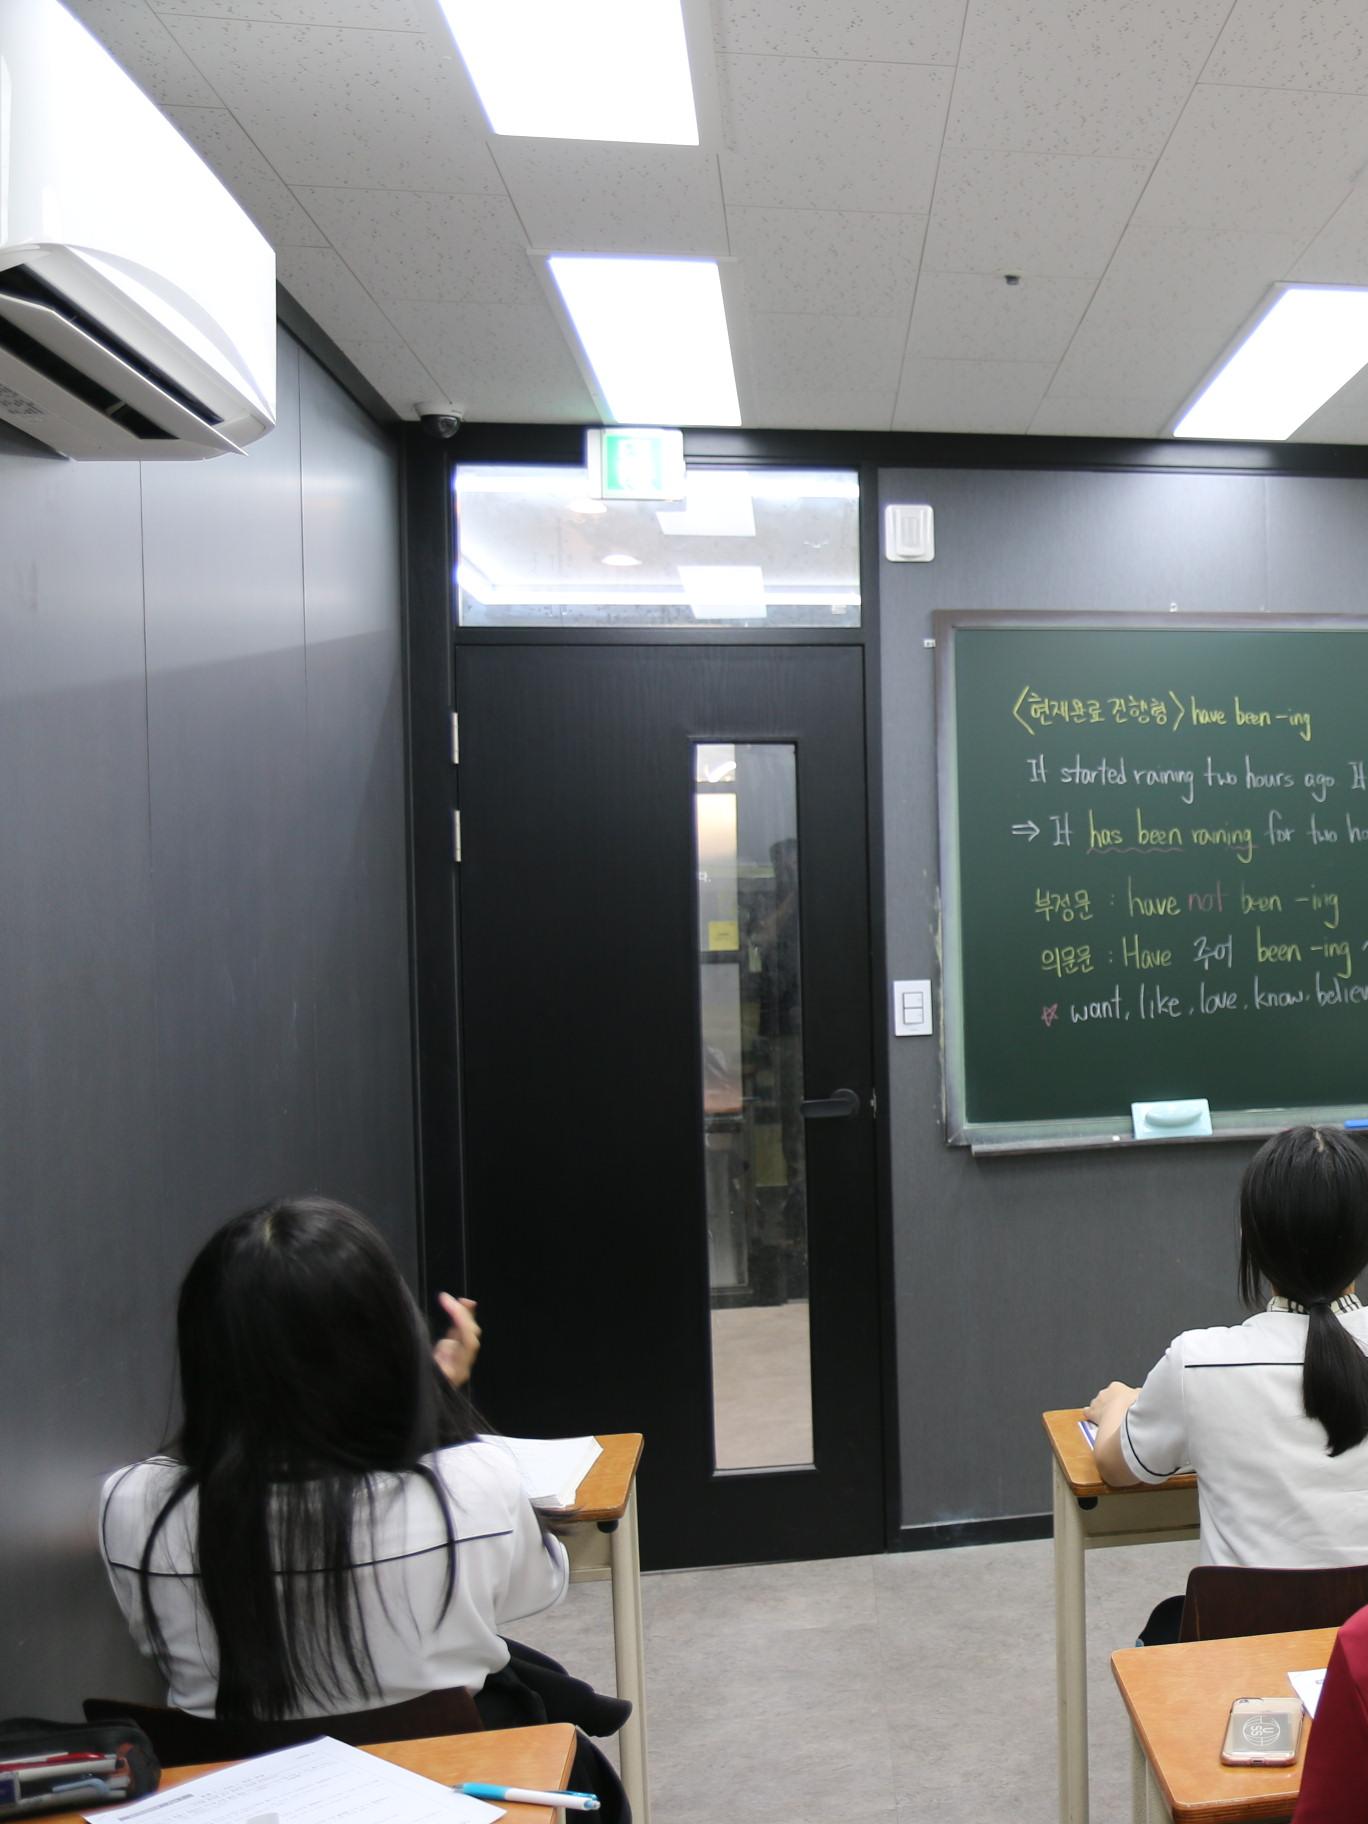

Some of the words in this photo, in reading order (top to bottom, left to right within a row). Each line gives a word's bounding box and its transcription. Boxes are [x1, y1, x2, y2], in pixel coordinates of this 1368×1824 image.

[1190, 695, 1227, 726] have
[1234, 696, 1271, 727] been
[1027, 753, 1048, 783] It
[1060, 753, 1127, 785] started
[1133, 764, 1194, 804] raining
[1204, 755, 1238, 787] two
[1245, 750, 1295, 789] hours
[1304, 773, 1335, 802] ago
[1348, 760, 1367, 790] It
[1050, 812, 1074, 847] It
[1088, 809, 1124, 849] has
[1136, 807, 1183, 846] been
[1191, 822, 1253, 864] raining
[1264, 809, 1294, 846] for
[1306, 813, 1338, 845] two
[1034, 887, 1093, 922] 부정문
[1127, 875, 1181, 917] have
[1187, 880, 1228, 913] not
[1240, 880, 1283, 915] been
[1041, 944, 1095, 978] 의문문
[1122, 933, 1172, 969] Have
[1193, 934, 1233, 971] 주어
[1256, 925, 1302, 963] been
